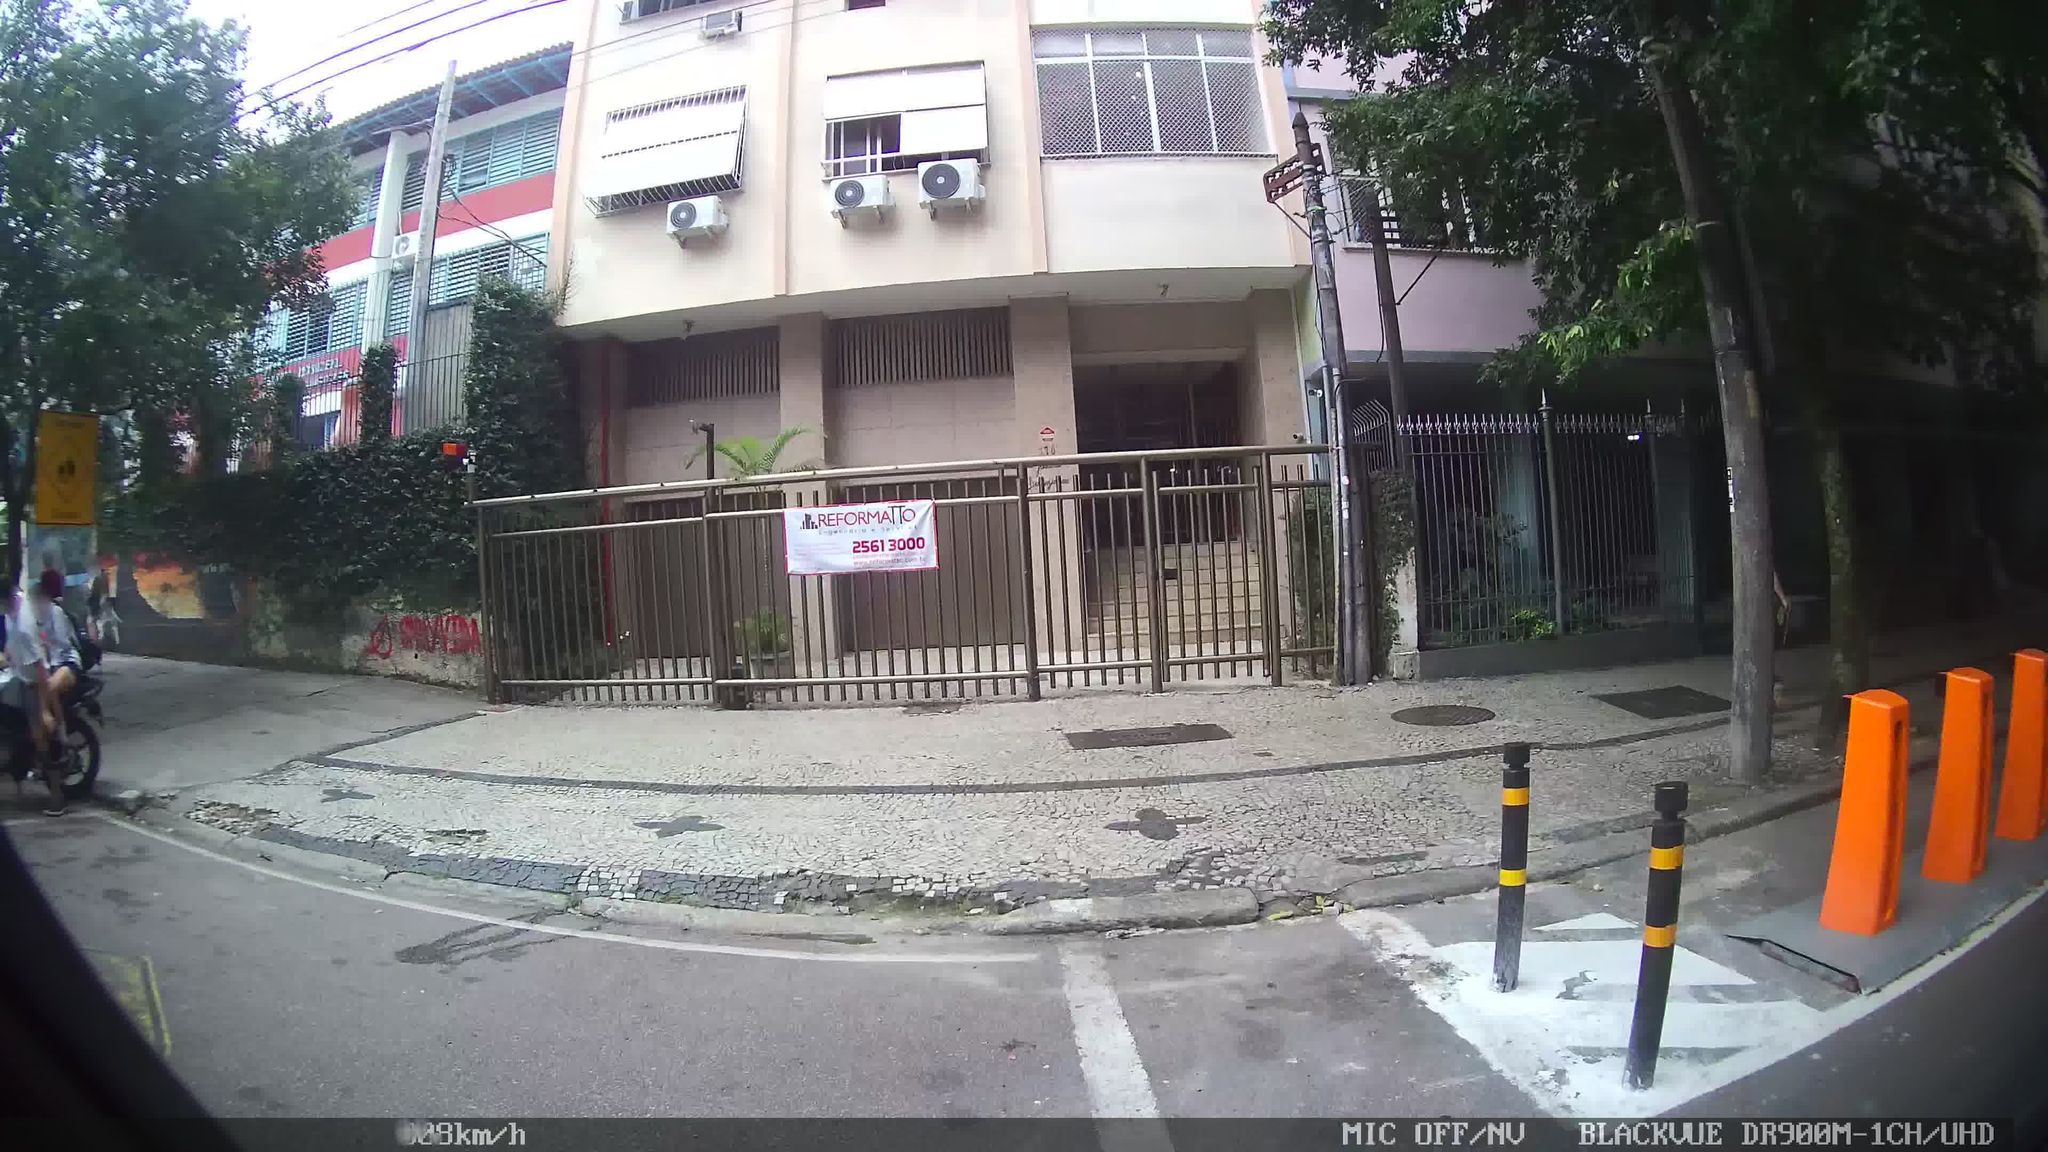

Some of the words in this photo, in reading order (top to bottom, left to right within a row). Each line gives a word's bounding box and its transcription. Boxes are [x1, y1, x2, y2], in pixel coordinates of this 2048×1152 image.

[818, 505, 916, 527] REFORMATTO
[852, 540, 885, 554] 2561
[888, 537, 925, 552] 3000
